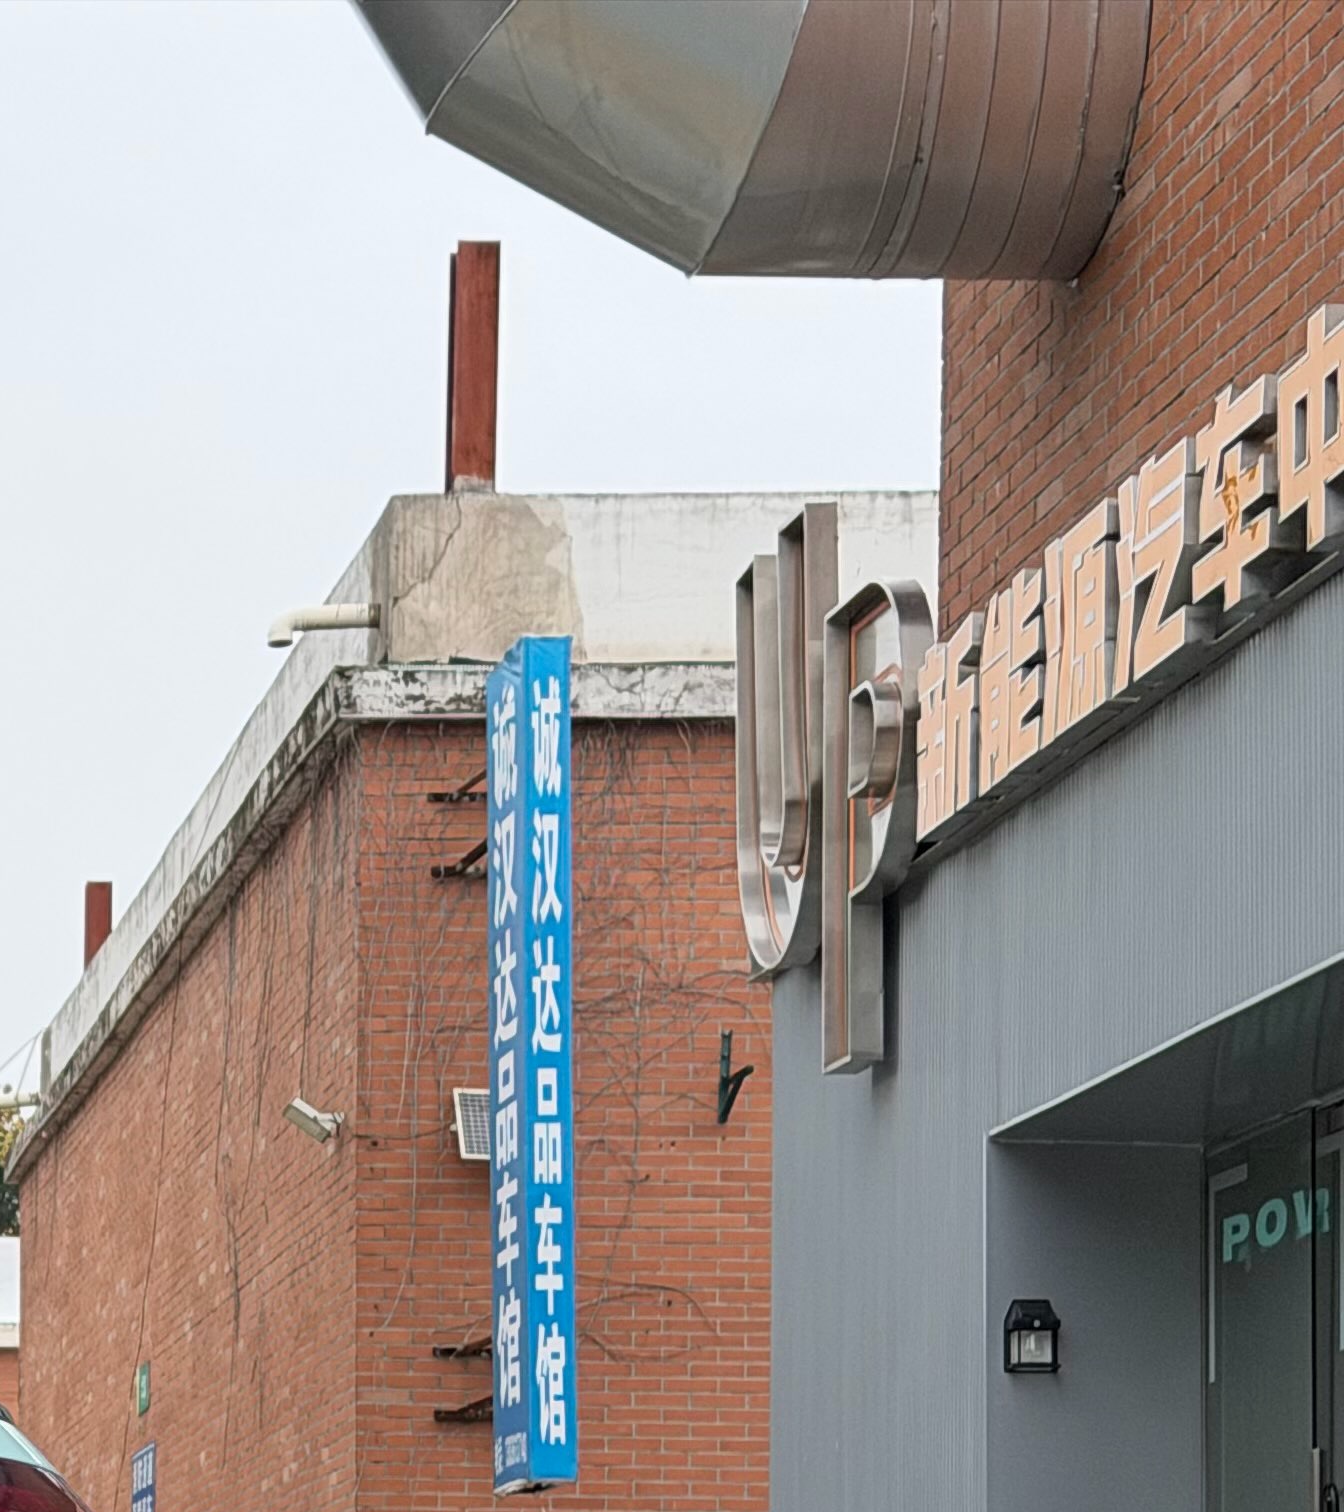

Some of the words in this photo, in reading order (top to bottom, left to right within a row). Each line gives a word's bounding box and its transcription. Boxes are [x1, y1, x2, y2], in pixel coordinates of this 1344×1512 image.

[916, 304, 1344, 845] 新能源汽车中
[492, 683, 522, 1408] 诚汉达品车馆
[531, 675, 567, 1446] 诚汉达品车馆
